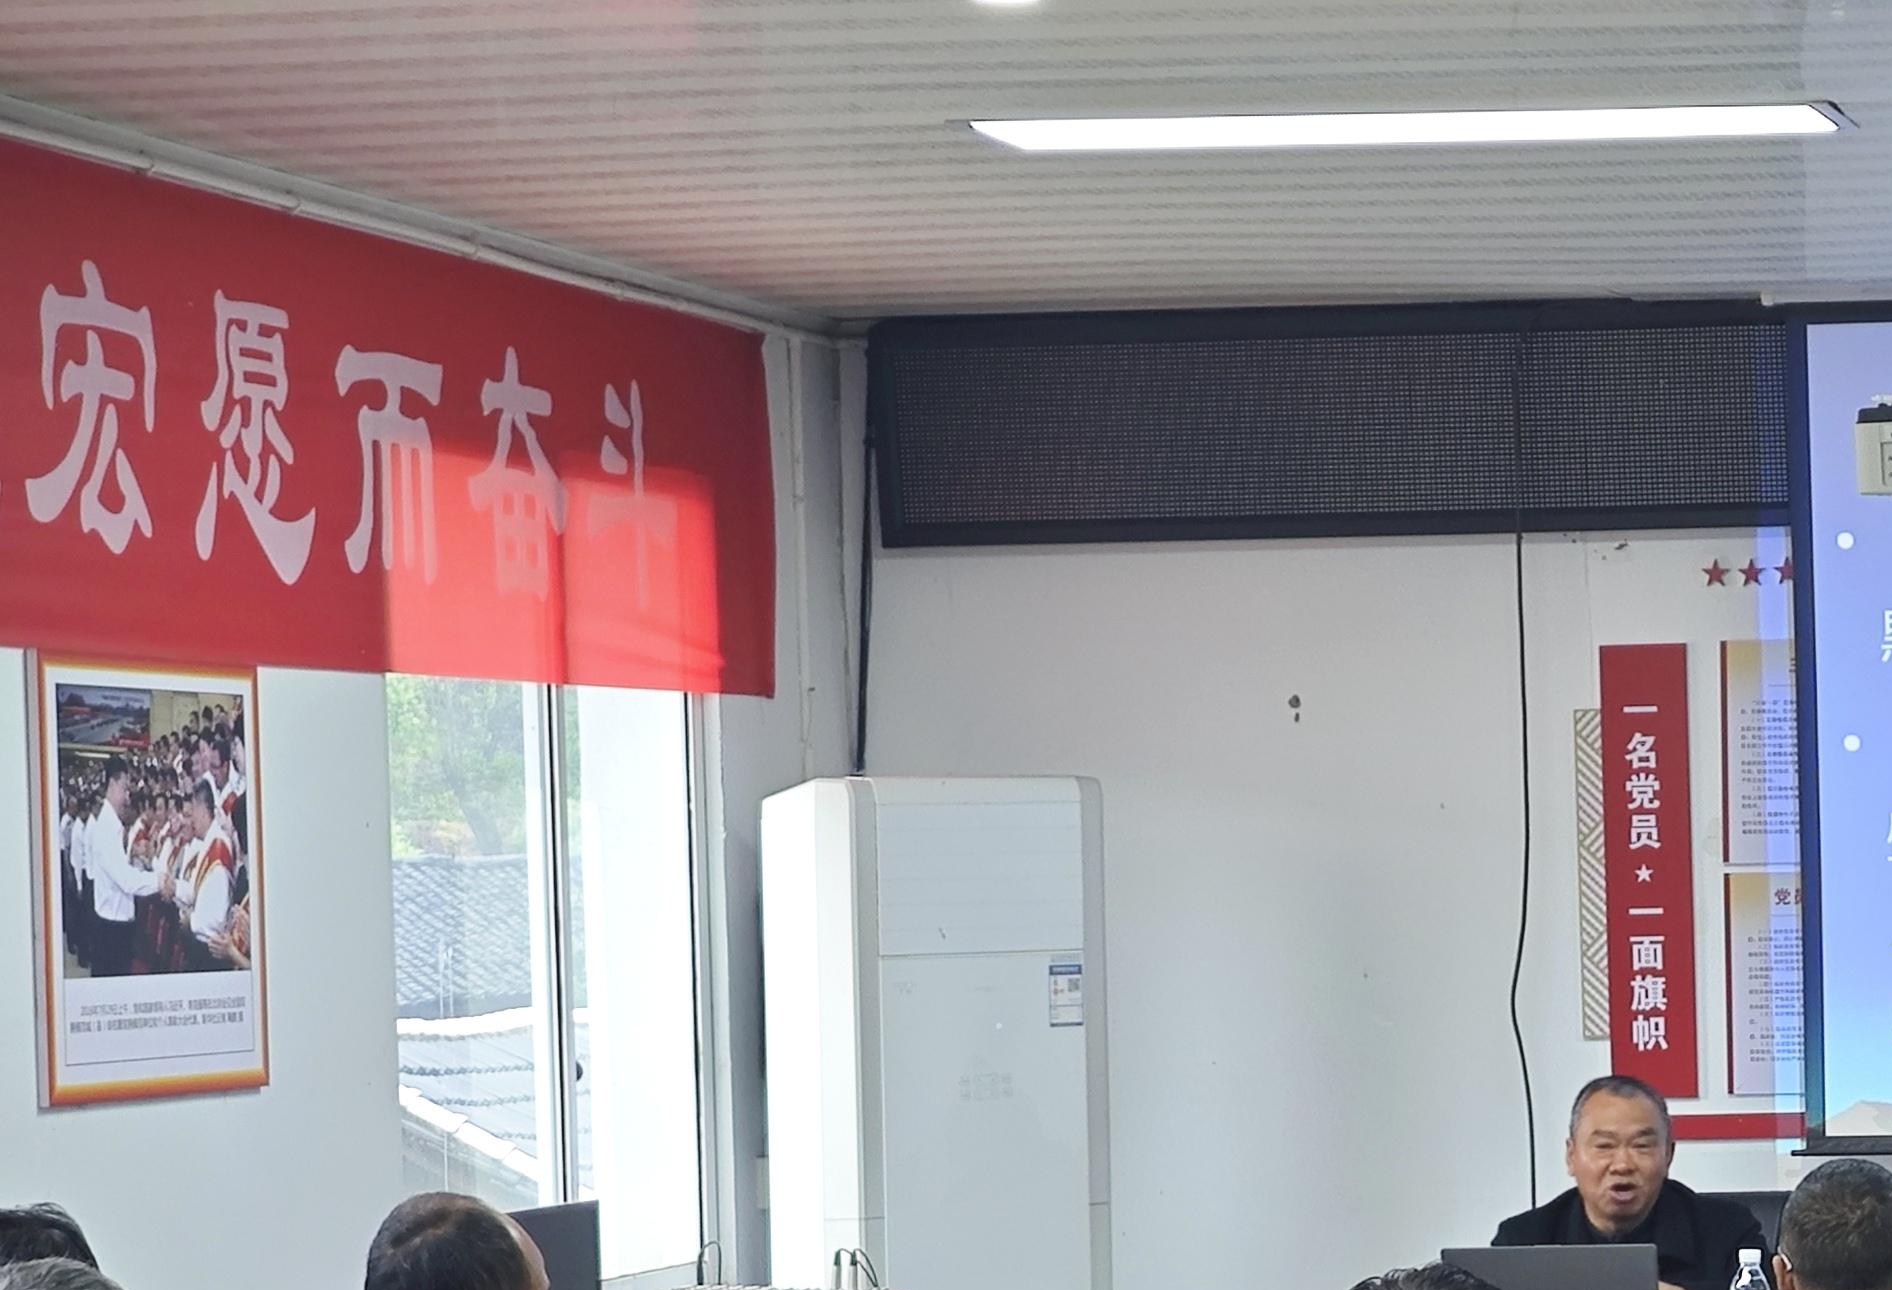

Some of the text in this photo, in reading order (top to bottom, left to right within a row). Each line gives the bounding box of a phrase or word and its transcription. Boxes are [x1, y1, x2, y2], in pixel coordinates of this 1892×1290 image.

[25, 258, 680, 611] 宏愿而奋斗
[1623, 704, 1669, 1051] 一名党员 一面旗帜
